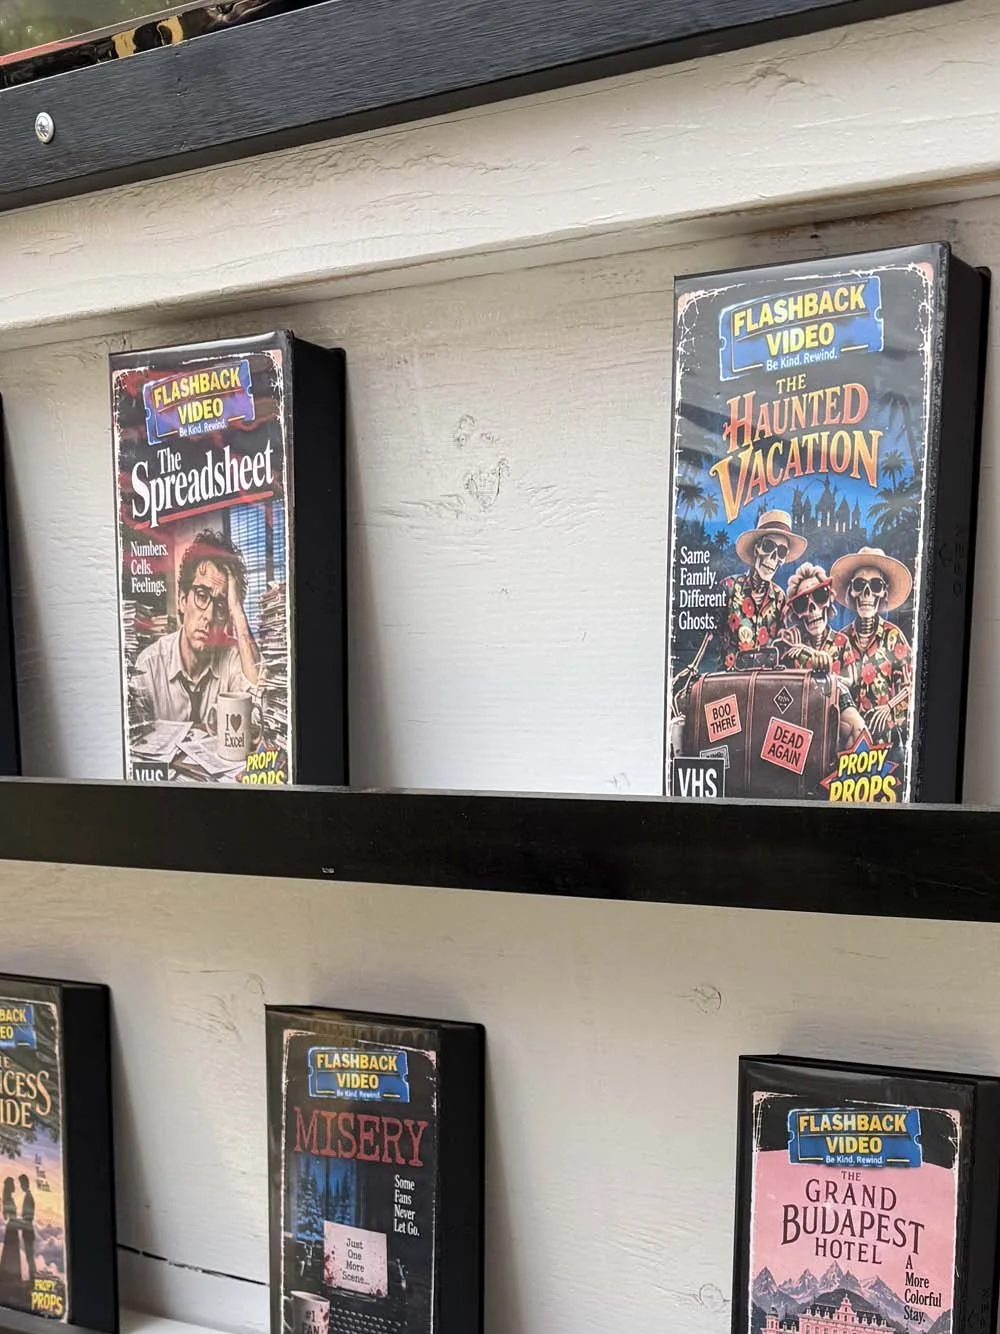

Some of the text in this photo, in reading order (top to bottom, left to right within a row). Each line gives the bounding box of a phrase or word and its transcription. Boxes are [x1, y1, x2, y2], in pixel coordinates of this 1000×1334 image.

[733, 284, 866, 336] FLASHBACK
[766, 322, 834, 356] VIDEO
[766, 350, 837, 371] Be Kind. Rewind.
[154, 366, 241, 408] FLASHBACK
[776, 374, 806, 394] THE
[177, 398, 224, 425] VIDEO
[722, 383, 869, 454] HAUNTED
[157, 447, 181, 474] The
[131, 439, 274, 528] Spreadsheet
[709, 430, 883, 524] VACATION
[130, 540, 169, 558] Numbers.
[680, 546, 710, 565] Same
[130, 559, 154, 576] Cells.
[680, 567, 717, 586] Family.
[130, 576, 167, 595] Feelings.
[680, 590, 726, 608] Different
[679, 612, 717, 630] Ghosts.
[712, 703, 731, 720] BOO
[710, 716, 737, 735] THERE
[224, 732, 245, 747] Excel
[773, 726, 804, 749] DEAD
[247, 751, 278, 771] PROPY
[768, 743, 801, 767] AGAIN
[838, 750, 888, 777] PROPY
[678, 767, 717, 797] VHS
[829, 775, 895, 803] PROPS
[317, 1053, 398, 1072] FLASHBACK
[337, 1073, 379, 1089] VIDEO
[800, 1114, 907, 1132] FLASHBACK
[293, 1105, 430, 1167] MISERY
[826, 1137, 882, 1153] VIDEO
[826, 1155, 834, 1164] Be
[836, 1156, 855, 1164] Kind.
[395, 1174, 415, 1191] Some
[841, 1170, 861, 1182] THE
[395, 1190, 412, 1205] Fans
[806, 1179, 897, 1211] GRAND
[394, 1204, 416, 1221] Never
[394, 1219, 420, 1237] Let Go.
[781, 1204, 924, 1255] BUDAPEST
[346, 1238, 364, 1250] Just
[815, 1237, 882, 1264] HOTEL
[347, 1250, 362, 1261] One
[906, 1255, 913, 1271] A
[346, 1261, 365, 1272] More
[905, 1272, 929, 1289] More
[31, 1292, 62, 1315] PROPS
[904, 1289, 942, 1308] Colorful
[904, 1305, 926, 1323] Stay.
